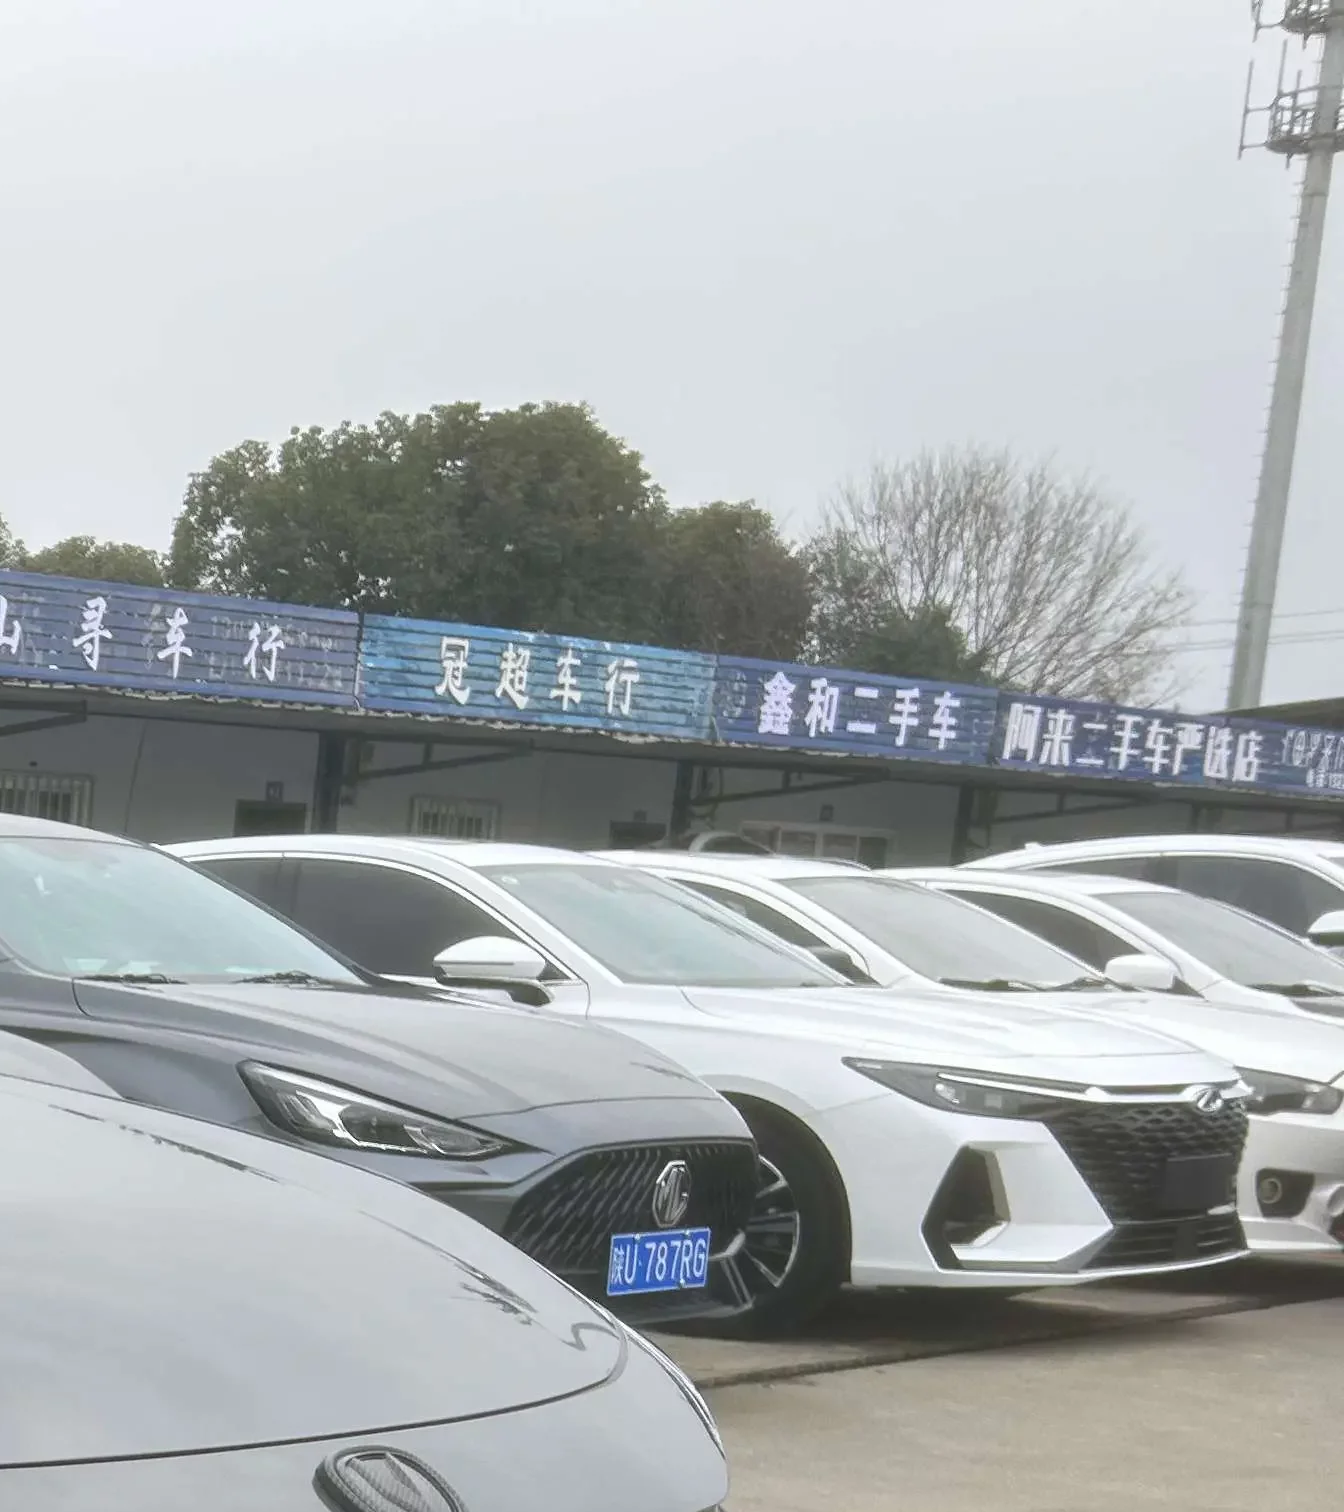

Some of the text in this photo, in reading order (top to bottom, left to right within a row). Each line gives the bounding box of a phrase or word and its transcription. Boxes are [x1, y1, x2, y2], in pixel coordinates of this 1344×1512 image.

[434, 636, 641, 717] 冠超车行
[757, 671, 962, 751] 鑫和二手车
